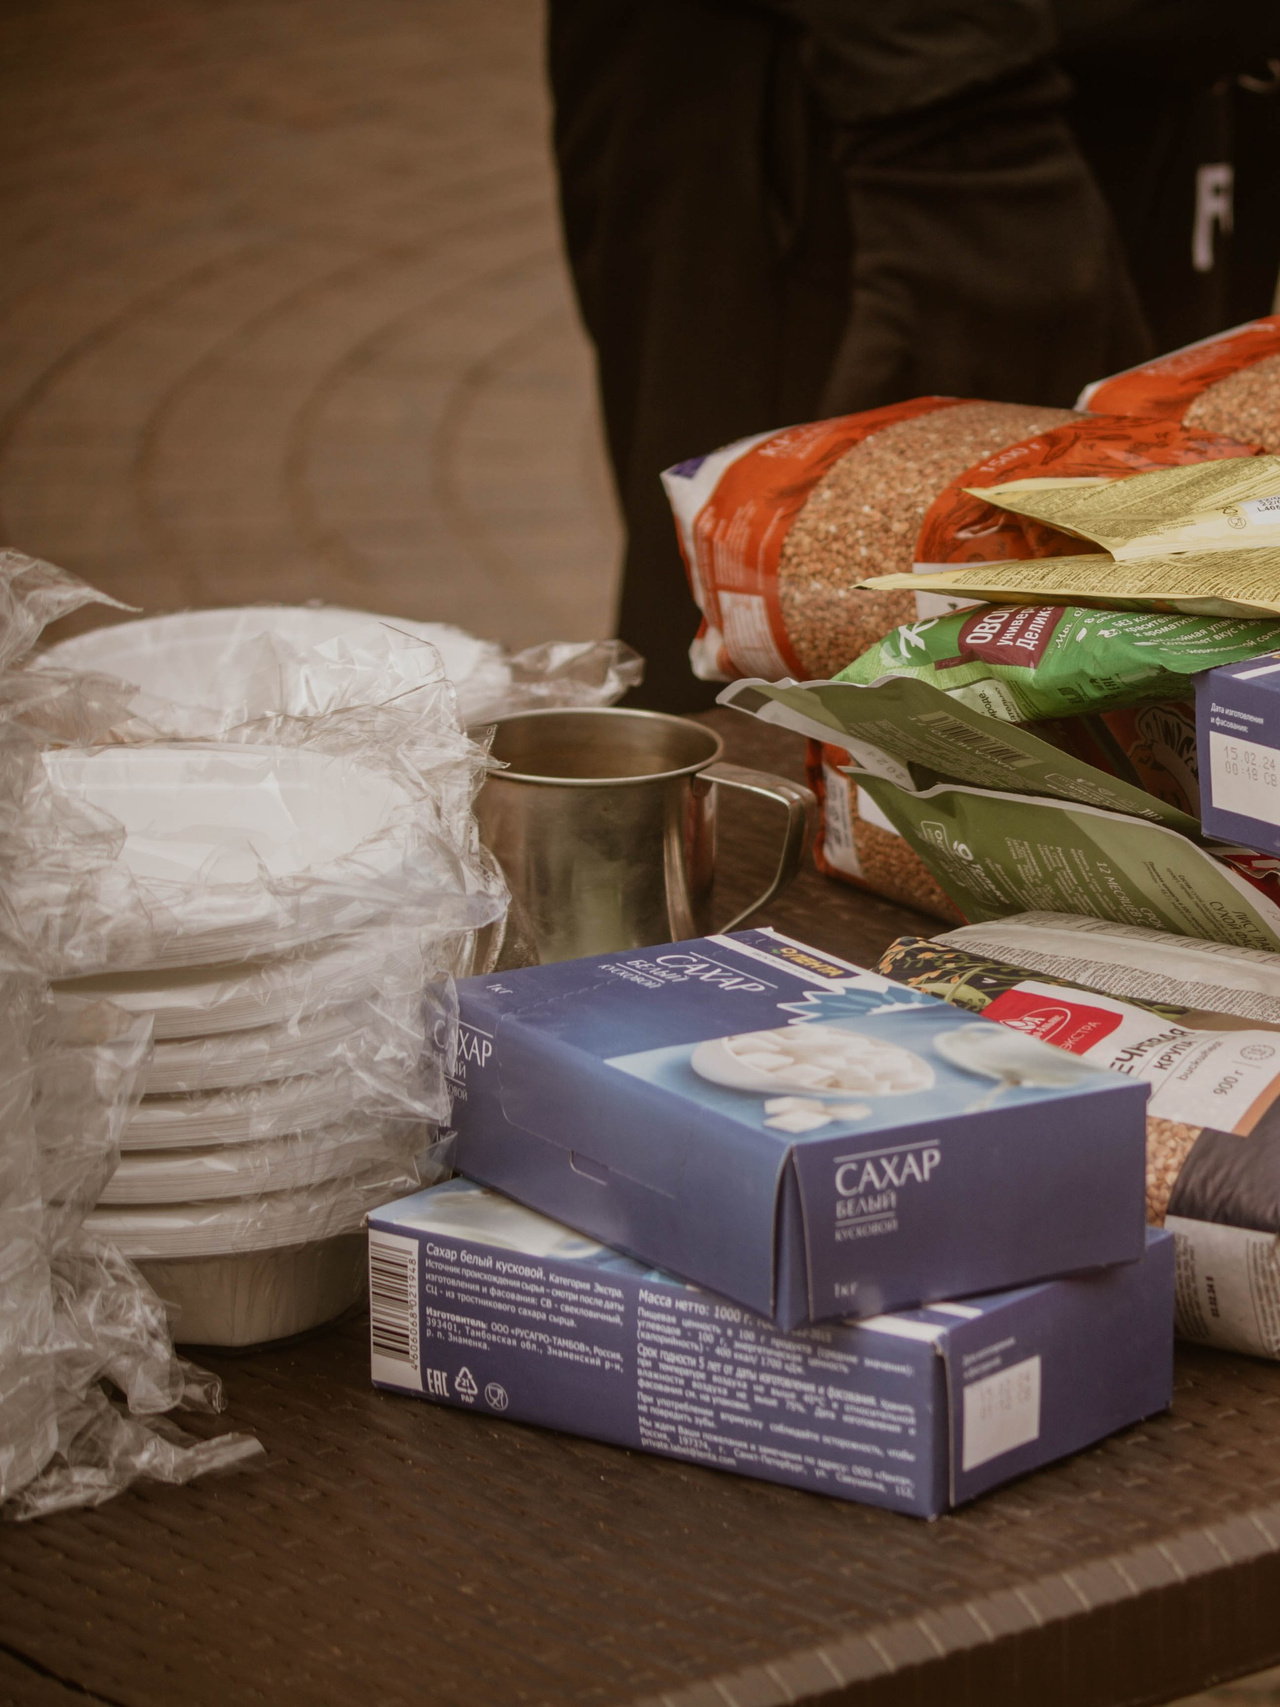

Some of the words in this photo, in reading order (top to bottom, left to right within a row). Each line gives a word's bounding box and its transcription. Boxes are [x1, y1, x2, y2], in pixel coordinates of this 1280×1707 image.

[979, 445, 1029, 473] 1500
[1210, 701, 1225, 715] Дата
[1225, 704, 1265, 726] изготовления
[1215, 715, 1250, 734] фасования:
[1223, 745, 1277, 771] 15.02.24
[1224, 761, 1259, 782] 00:18
[1209, 900, 1239, 932] СУХОЙ
[1232, 909, 1254, 938] ЛИСТ
[598, 963, 662, 990] КУСКОВОЙ
[624, 958, 689, 983] БЕЛЫЙ
[655, 953, 767, 994] САХАР
[796, 950, 845, 978] ЛЕНТА
[1154, 1038, 1197, 1072] КРУПА
[1213, 1076, 1239, 1096] 900
[834, 1148, 942, 1197] САХАР
[835, 1189, 898, 1221] БЕЛЫЙ
[835, 1218, 898, 1242] КУСКОВОЙ
[426, 1242, 456, 1262] Сахар
[460, 1249, 492, 1269] белый
[495, 1257, 546, 1283] кусковой.
[548, 1272, 590, 1292] Категория
[593, 1281, 624, 1299] Экстра.
[638, 1287, 673, 1309] Масса
[675, 1297, 709, 1317] нетто:
[714, 1307, 740, 1324] 1000
